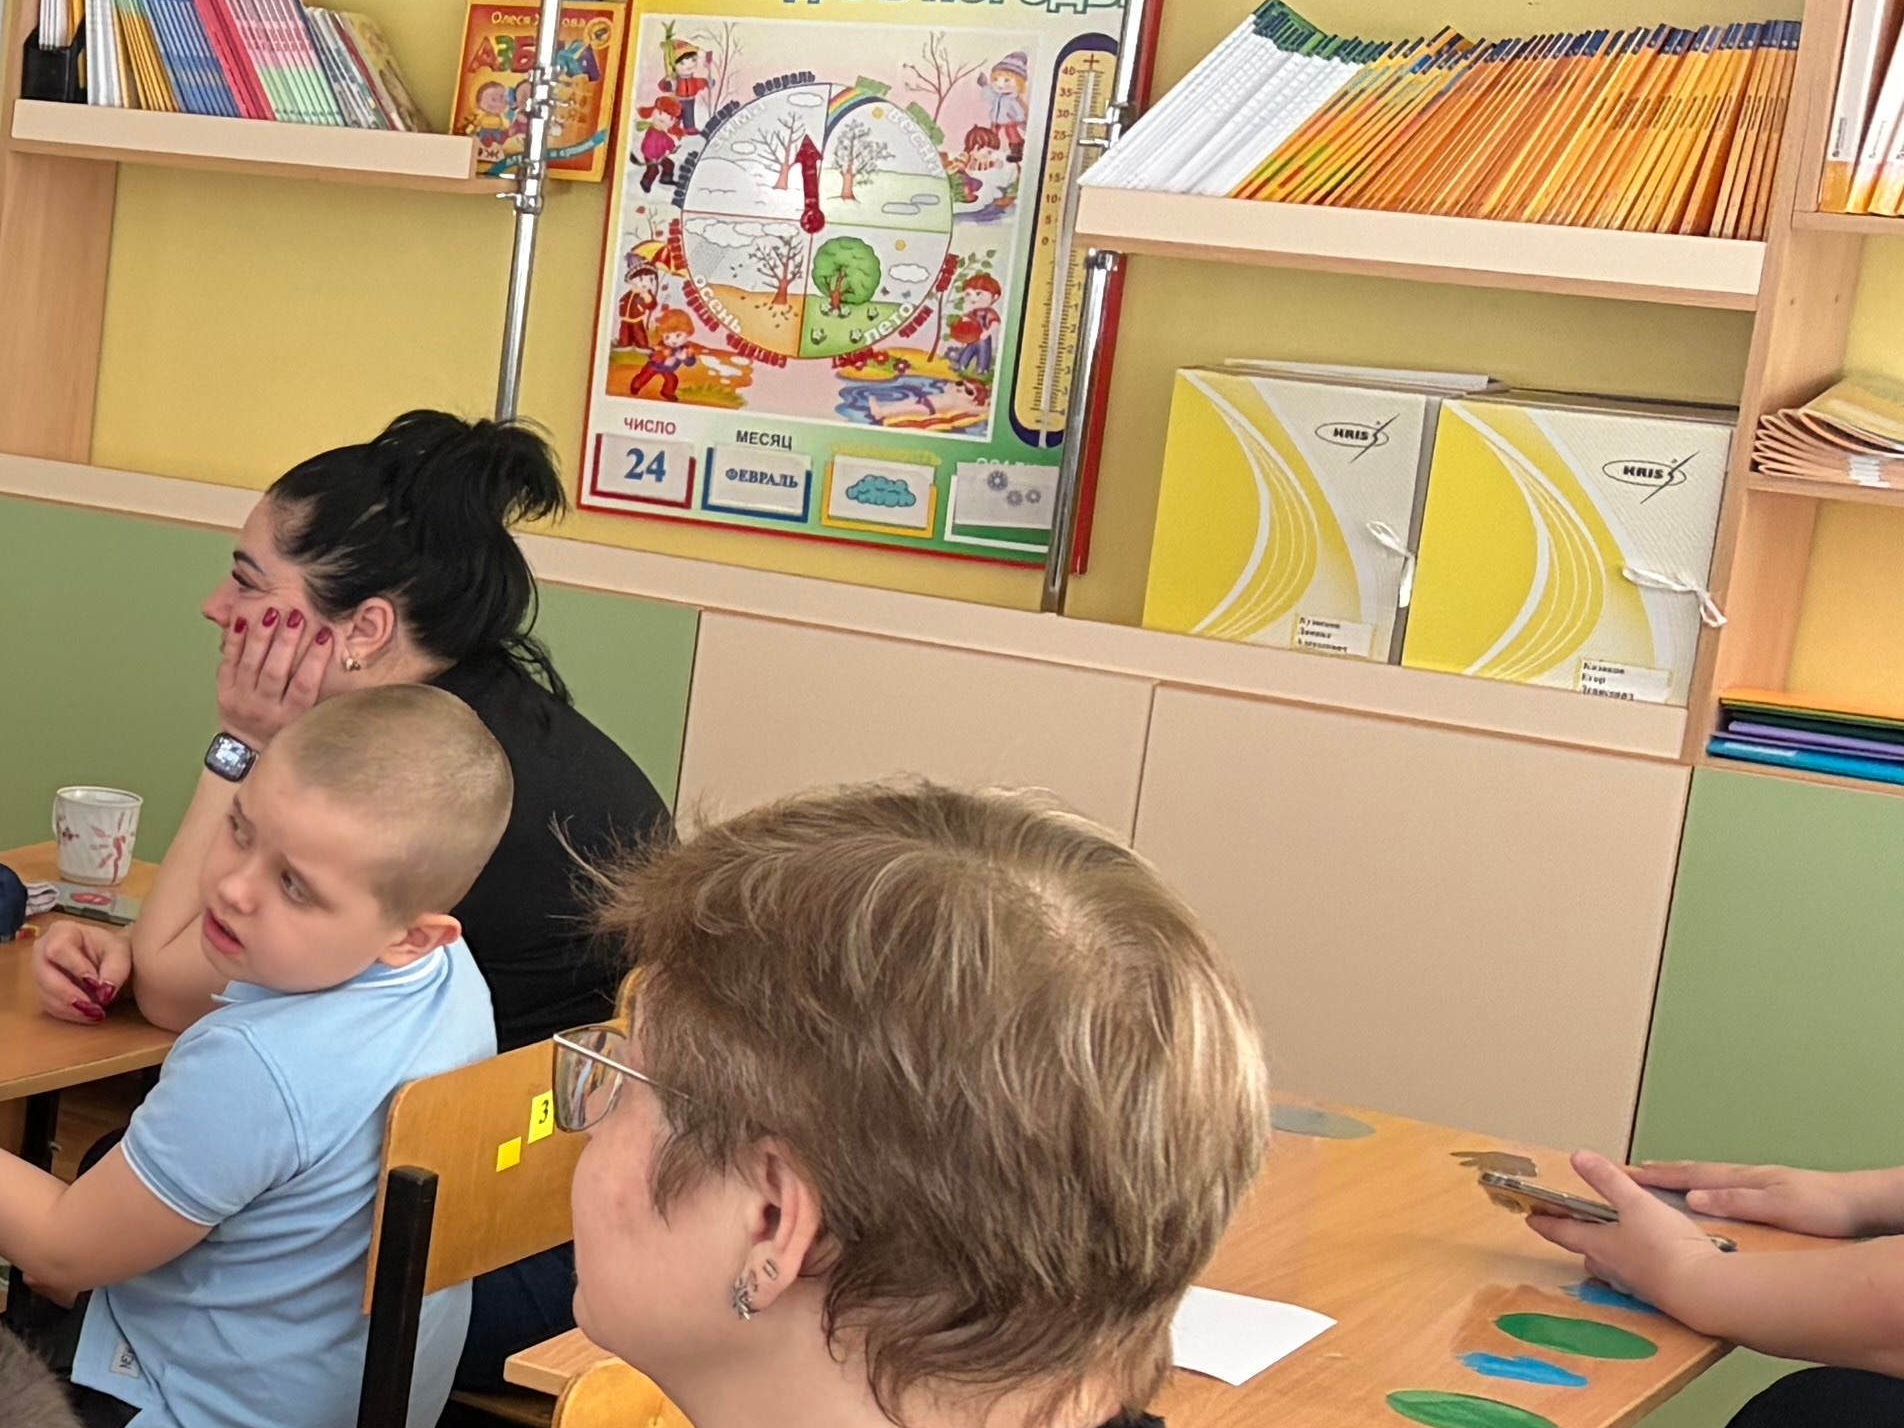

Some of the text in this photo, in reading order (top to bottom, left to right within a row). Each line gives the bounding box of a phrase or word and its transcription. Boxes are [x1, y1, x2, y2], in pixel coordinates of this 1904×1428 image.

[468, 35, 601, 82] АЗБКА
[1056, 110, 1070, 118] 30
[1053, 131, 1066, 140] 25
[1050, 152, 1064, 161] 20
[694, 274, 741, 334] осень
[864, 303, 913, 344] лето
[624, 417, 676, 435] ЧИСЛО
[736, 430, 792, 451] МЕСЯЦ
[624, 447, 667, 483] 24
[725, 468, 798, 488] ФЕВРАЛЬ
[538, 1099, 549, 1125] 3
